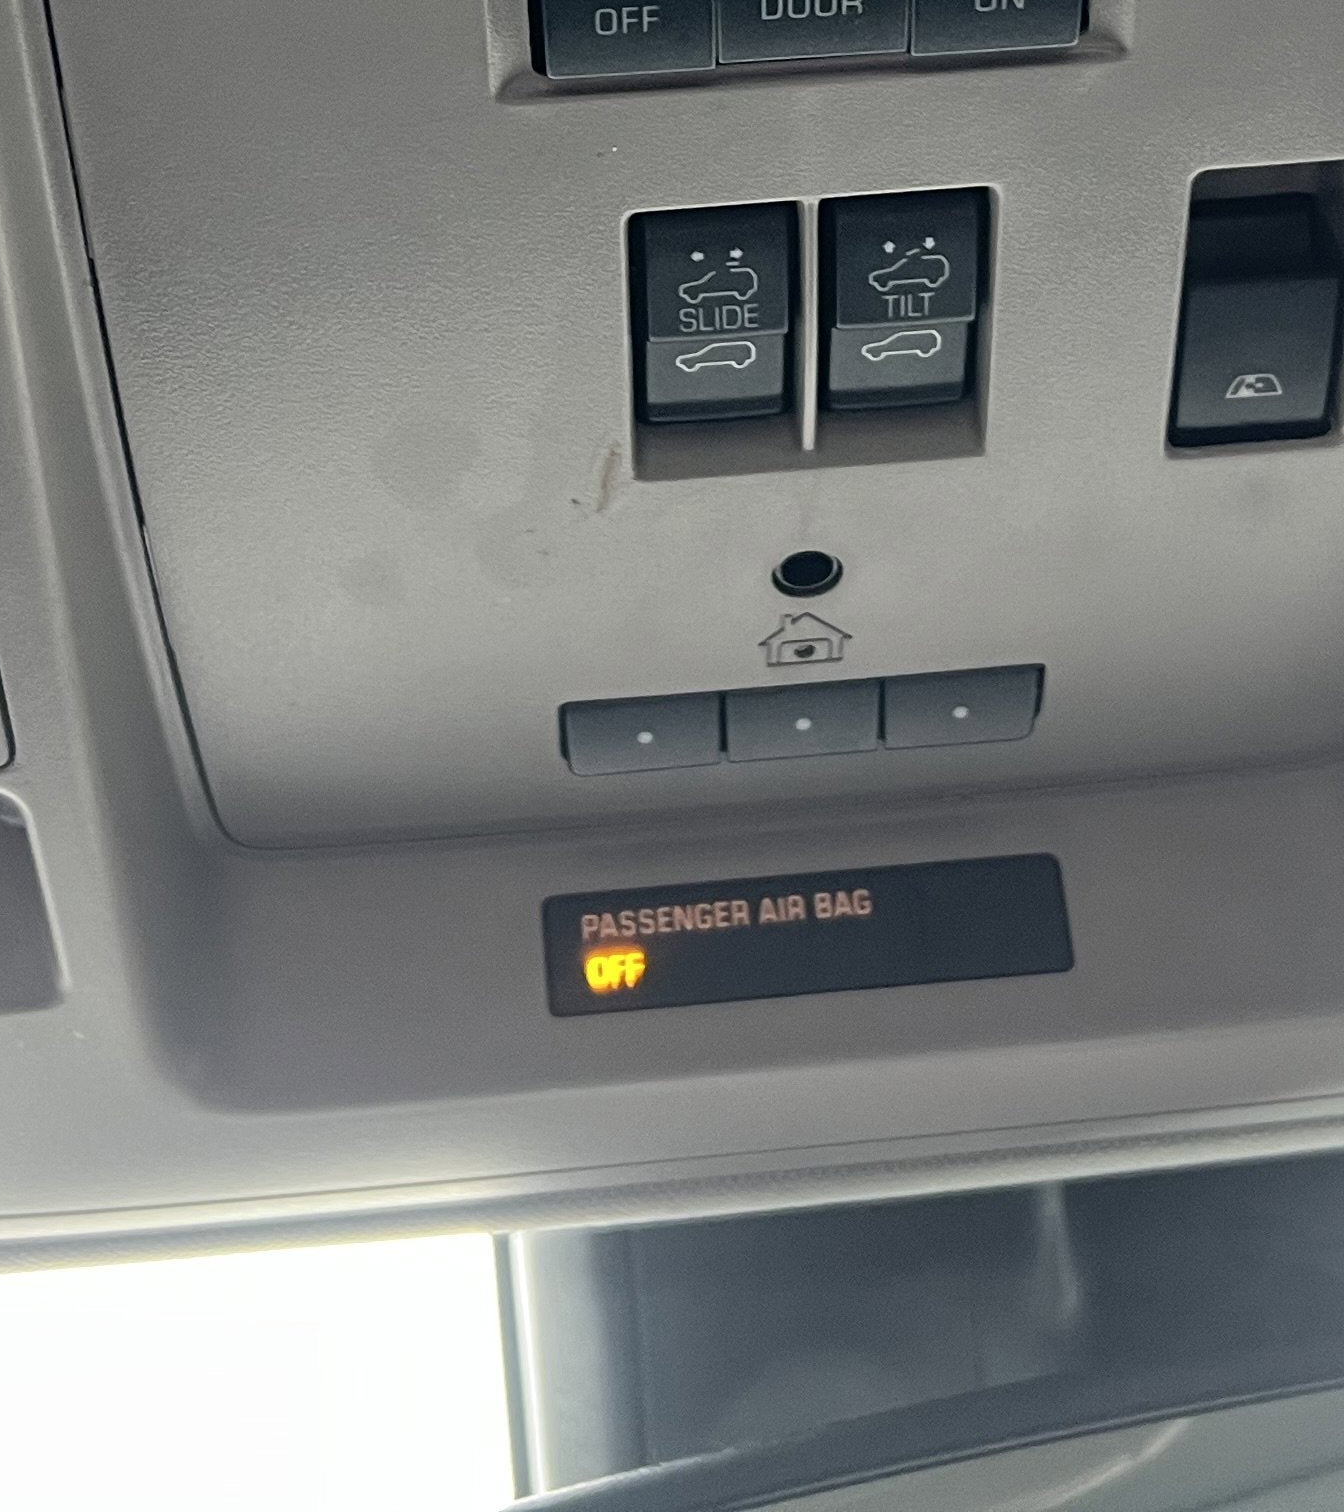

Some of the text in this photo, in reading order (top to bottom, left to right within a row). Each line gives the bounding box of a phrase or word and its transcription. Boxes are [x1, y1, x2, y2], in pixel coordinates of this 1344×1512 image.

[593, 6, 661, 36] OFF
[678, 303, 760, 334] SLIDE
[880, 291, 936, 319] TILT
[581, 889, 873, 939] PASSENGER AIR BAG
[584, 949, 646, 991] OFF
